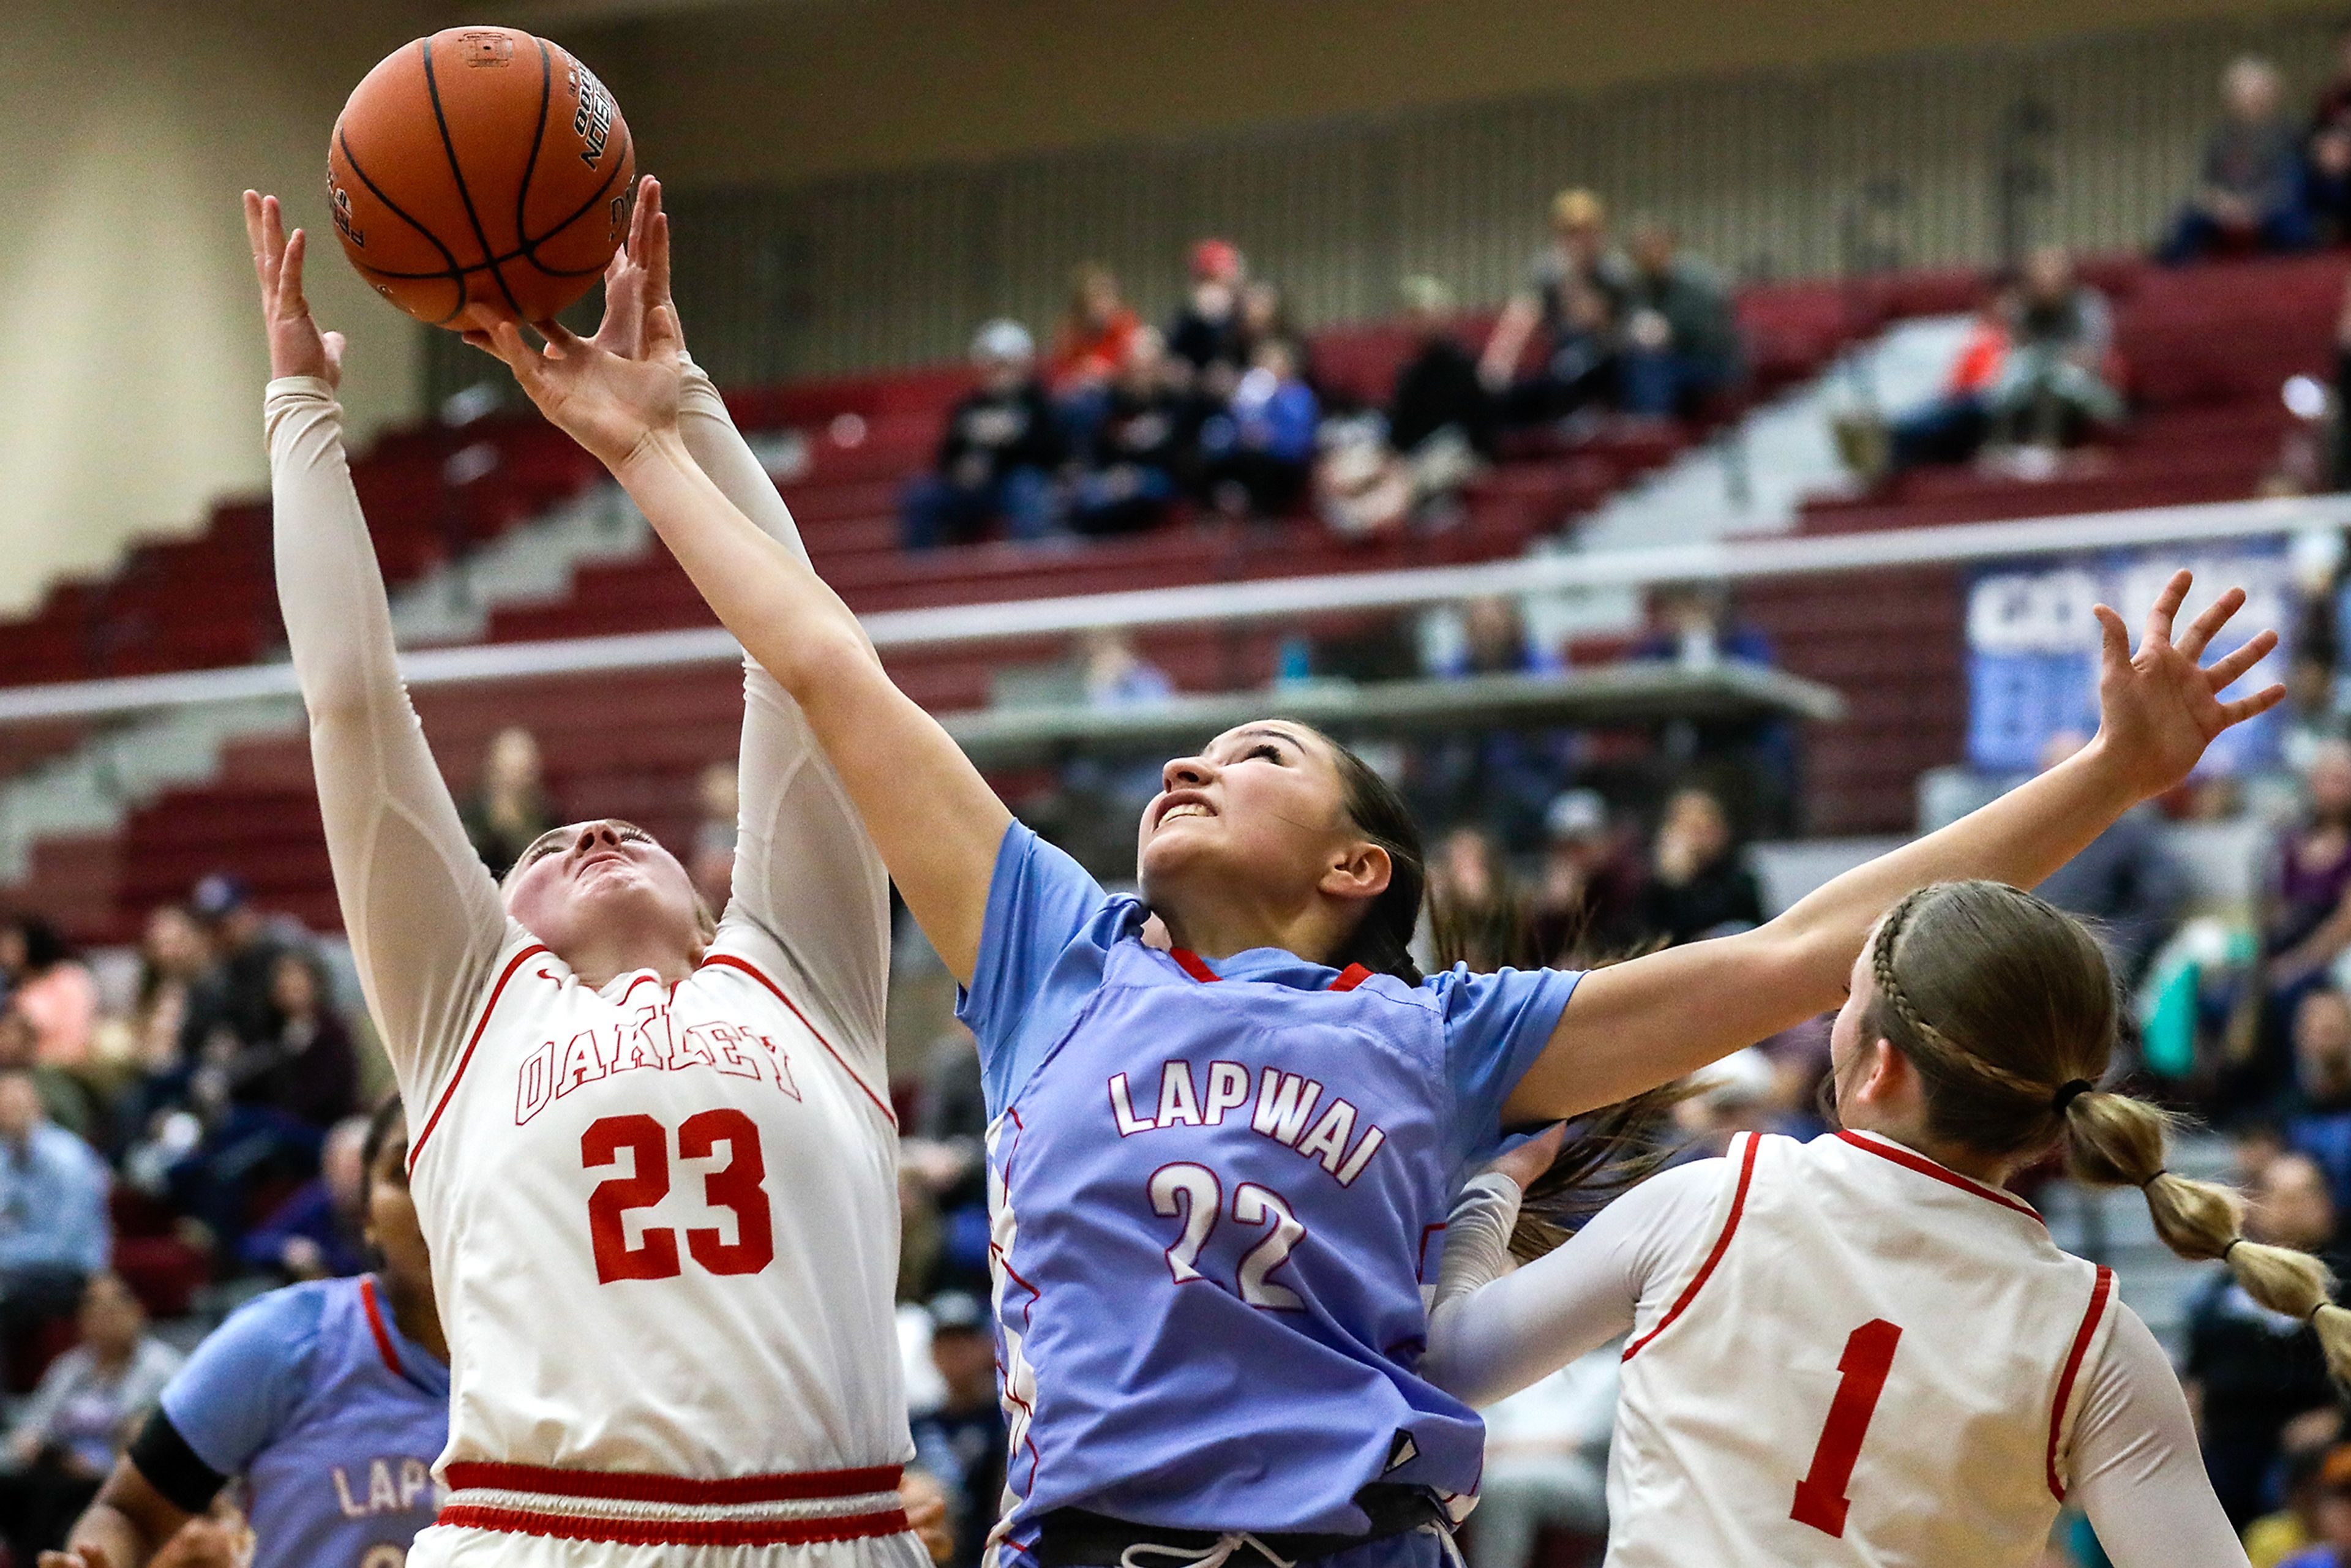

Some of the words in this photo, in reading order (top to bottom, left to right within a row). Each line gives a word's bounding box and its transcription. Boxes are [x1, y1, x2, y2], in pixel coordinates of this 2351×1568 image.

[516, 1004, 801, 1126] OAKLEY
[1108, 1059, 1386, 1188] LAPWAI
[581, 1108, 774, 1285] 23
[1147, 1161, 1307, 1311] 22
[331, 1457, 442, 1517] LAP
[1789, 1318, 1903, 1539] 1
